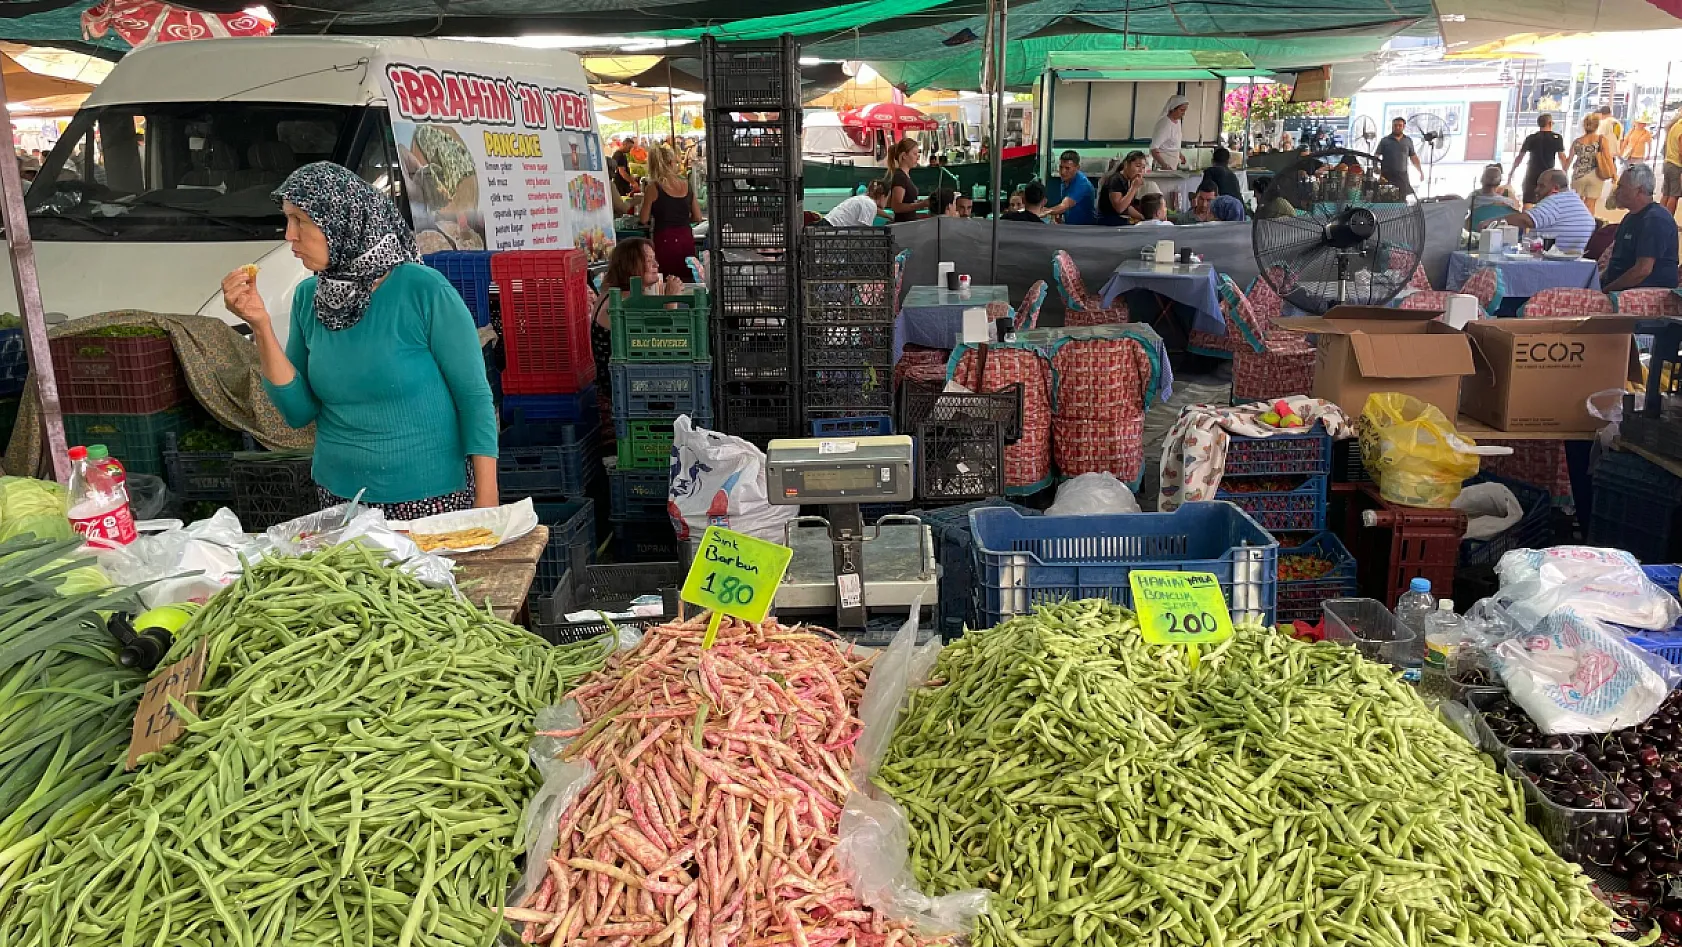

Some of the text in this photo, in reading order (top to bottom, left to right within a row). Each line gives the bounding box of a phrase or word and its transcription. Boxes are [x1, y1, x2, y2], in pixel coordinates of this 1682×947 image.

[484, 131, 543, 158] PANCAKE
[1515, 342, 1585, 362] ECOR
[700, 571, 755, 605] 180
[1165, 612, 1218, 635] 200
